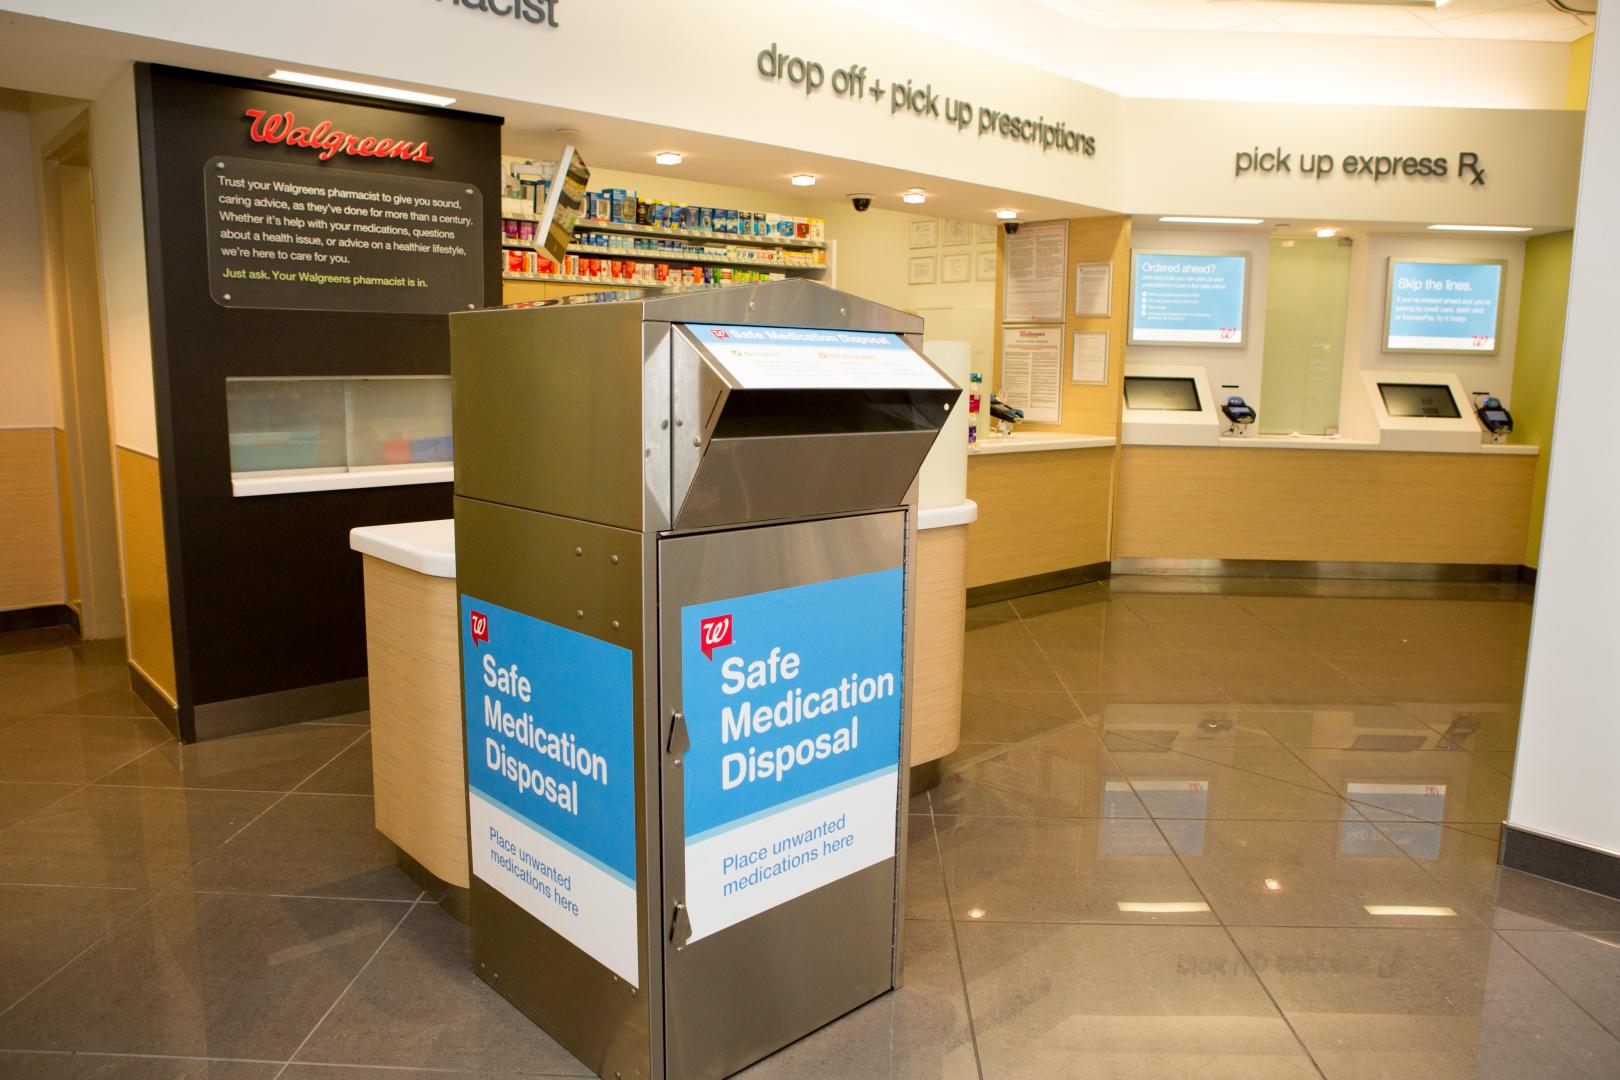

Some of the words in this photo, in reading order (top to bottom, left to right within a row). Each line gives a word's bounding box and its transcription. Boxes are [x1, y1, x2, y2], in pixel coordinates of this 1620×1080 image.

[436, 0, 559, 28] cist
[757, 43, 825, 95] drop
[831, 64, 867, 98] off
[891, 79, 939, 117] pick
[945, 96, 973, 132] up
[978, 105, 1096, 157] prescriptions
[245, 108, 434, 164] Walgreens
[1235, 147, 1291, 177] pick
[1300, 153, 1333, 180] up
[1342, 153, 1448, 182] express
[1458, 152, 1485, 185] Rx
[217, 175, 245, 189] Trust
[248, 181, 271, 191] your
[273, 181, 326, 196] Walgreens
[328, 187, 380, 199] pharmacist
[382, 193, 392, 202] to
[393, 195, 412, 205] give
[414, 198, 431, 207] you
[432, 199, 462, 210] sound,
[218, 195, 252, 208] caring
[253, 198, 291, 210] advice,
[292, 202, 305, 211] as
[307, 202, 342, 215] they've
[344, 205, 368, 217] done
[370, 207, 383, 217] for
[384, 210, 409, 220] more
[410, 212, 430, 221] than
[431, 214, 438, 222] a
[439, 215, 474, 227] century.
[219, 211, 264, 224] Whether
[266, 215, 282, 226] it's
[283, 216, 305, 228] help
[307, 219, 328, 229] with
[329, 222, 352, 232] your
[353, 223, 411, 237] medications,
[413, 228, 455, 239] questions
[220, 229, 251, 241] about
[253, 233, 260, 241] a
[262, 231, 293, 243] health
[295, 234, 324, 246] issue,
[326, 238, 336, 246] or
[338, 237, 370, 248] advice
[371, 241, 383, 250] on
[385, 242, 392, 250] a
[393, 241, 431, 253] healthier
[432, 244, 467, 257] lifestyle,
[221, 246, 250, 257] we're
[252, 248, 276, 259] here
[277, 250, 288, 260] to
[290, 252, 312, 261] care
[314, 252, 328, 262] for
[329, 254, 351, 265] you.
[222, 268, 247, 279] Just
[248, 270, 271, 280] ask.
[271, 270, 297, 281] Your
[298, 272, 351, 285] Walgreens
[353, 275, 406, 286] pharmacist
[407, 277, 416, 287] is
[417, 278, 428, 287] in.
[1142, 262, 1180, 273] Ordered
[1182, 263, 1217, 274] ahead?
[1397, 277, 1423, 292] Skip
[1425, 278, 1443, 291] the
[1445, 279, 1473, 292] lines.
[729, 329, 764, 340] Safe
[766, 330, 838, 343] Medication
[839, 333, 892, 346] Disposal
[482, 653, 532, 703] Safe
[721, 646, 800, 696] Safe
[721, 671, 894, 745] Medication
[484, 694, 608, 786] Medication
[721, 716, 858, 791] Disposal
[485, 737, 578, 817] Disposal
[489, 826, 517, 856] Place
[519, 850, 572, 892] unwanted
[722, 848, 768, 875] Place
[772, 813, 846, 856] unwanted
[723, 850, 819, 897] medications
[822, 832, 855, 858] here
[490, 848, 552, 896] medications
[554, 889, 580, 918] here
